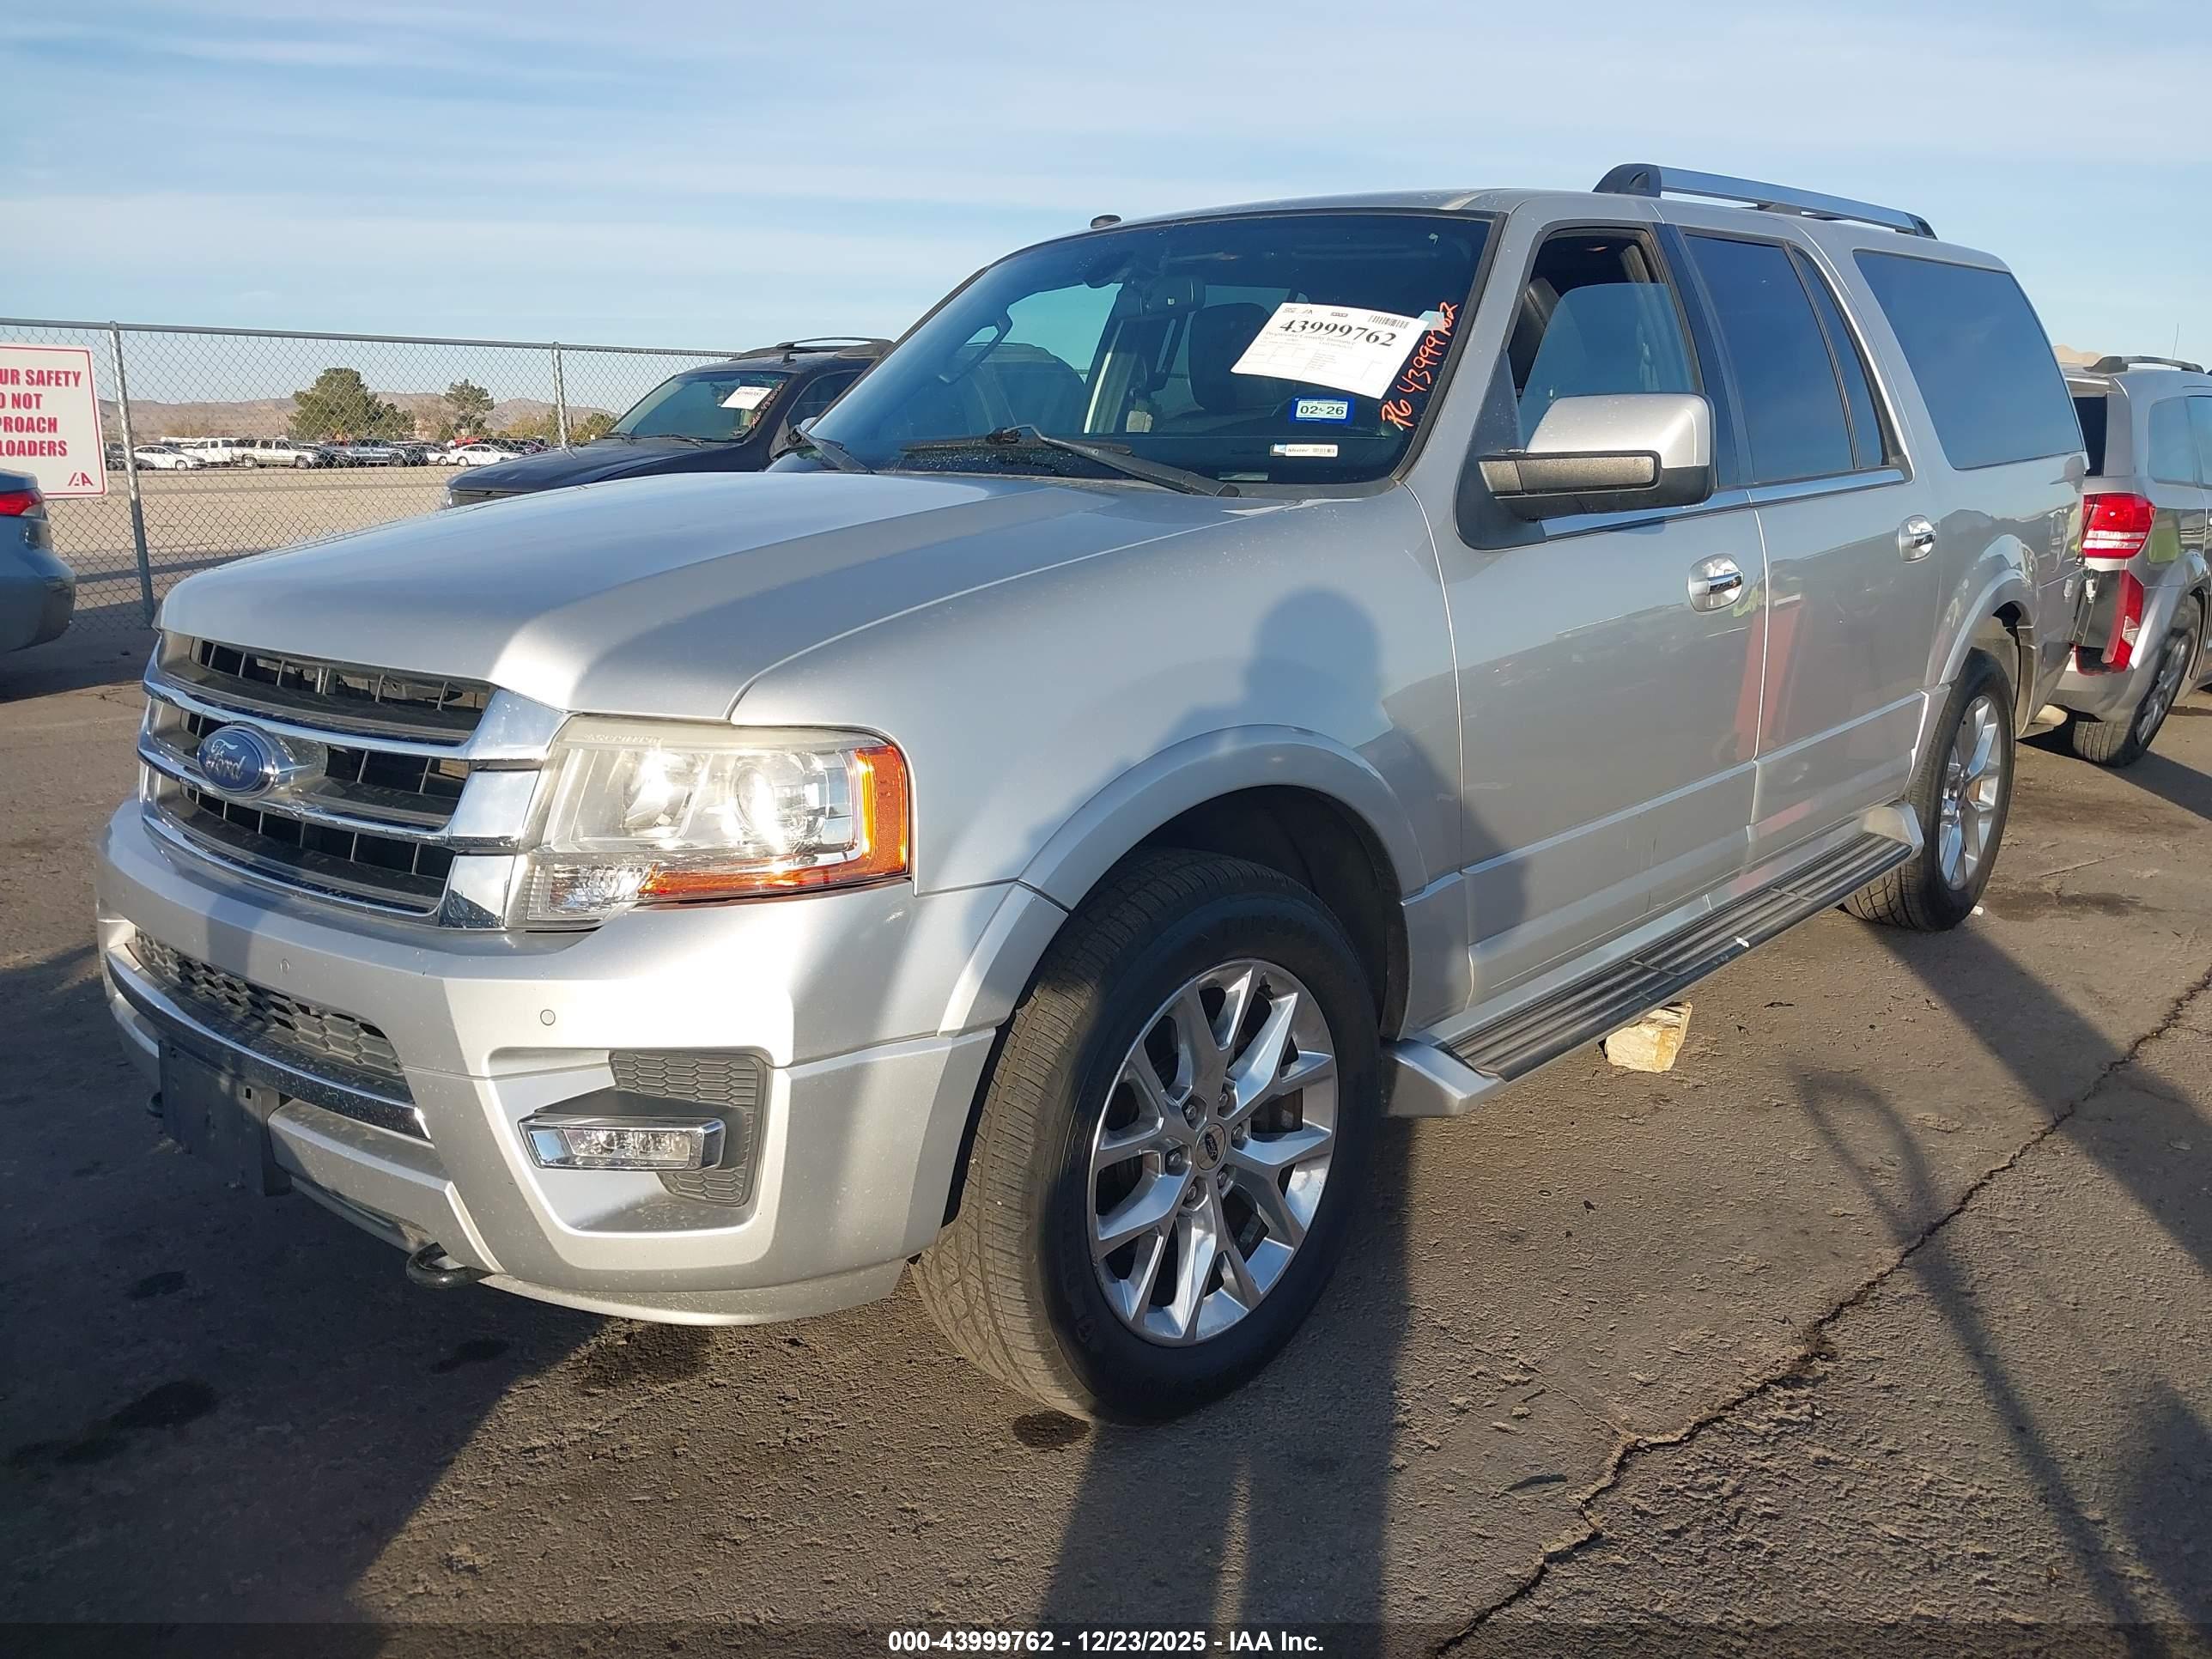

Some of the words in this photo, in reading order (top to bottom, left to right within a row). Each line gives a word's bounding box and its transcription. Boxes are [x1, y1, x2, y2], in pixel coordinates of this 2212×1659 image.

[1279, 319, 1397, 346] 43999762
[26, 369, 82, 387] SAFETY
[11, 392, 42, 410] NOT
[0, 416, 58, 434] ROACH
[208, 738, 246, 781] Ford
